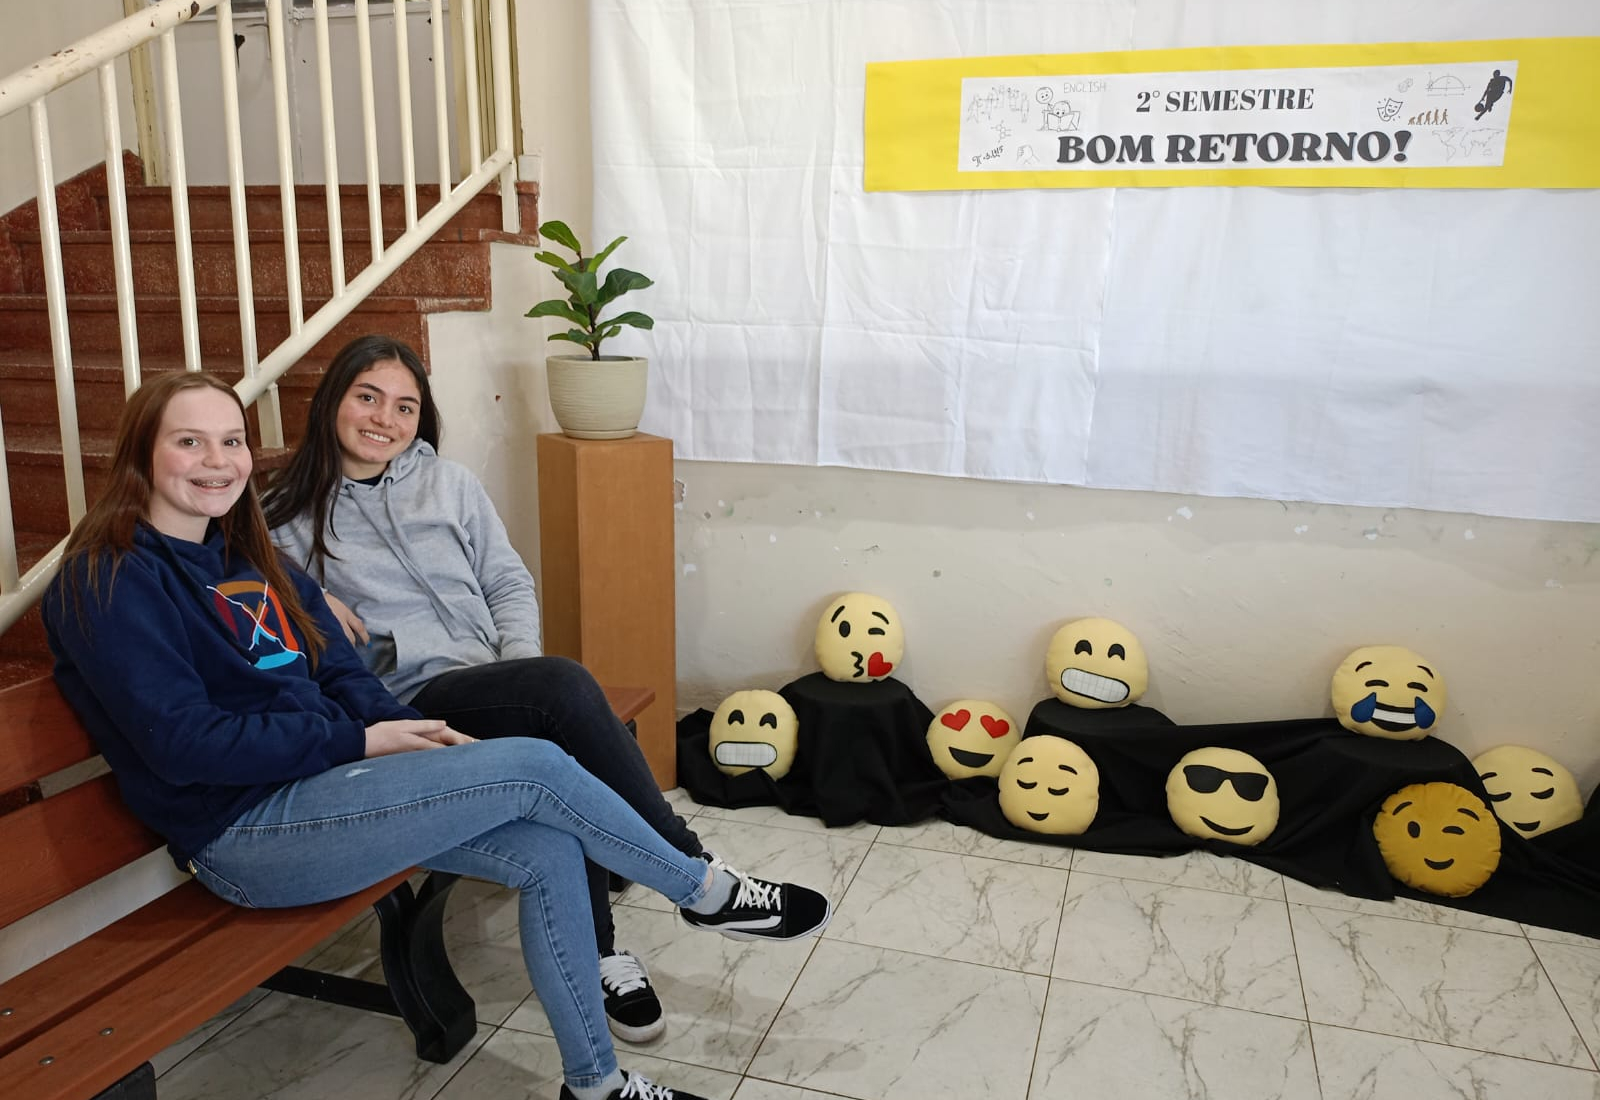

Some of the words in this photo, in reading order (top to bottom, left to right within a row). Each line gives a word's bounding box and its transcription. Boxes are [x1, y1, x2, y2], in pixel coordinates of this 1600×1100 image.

[1063, 81, 1107, 94] ENGLISH
[1165, 88, 1315, 113] SEMESTRE
[1056, 134, 1156, 164] BOM
[1164, 130, 1412, 164] RETORNO!
